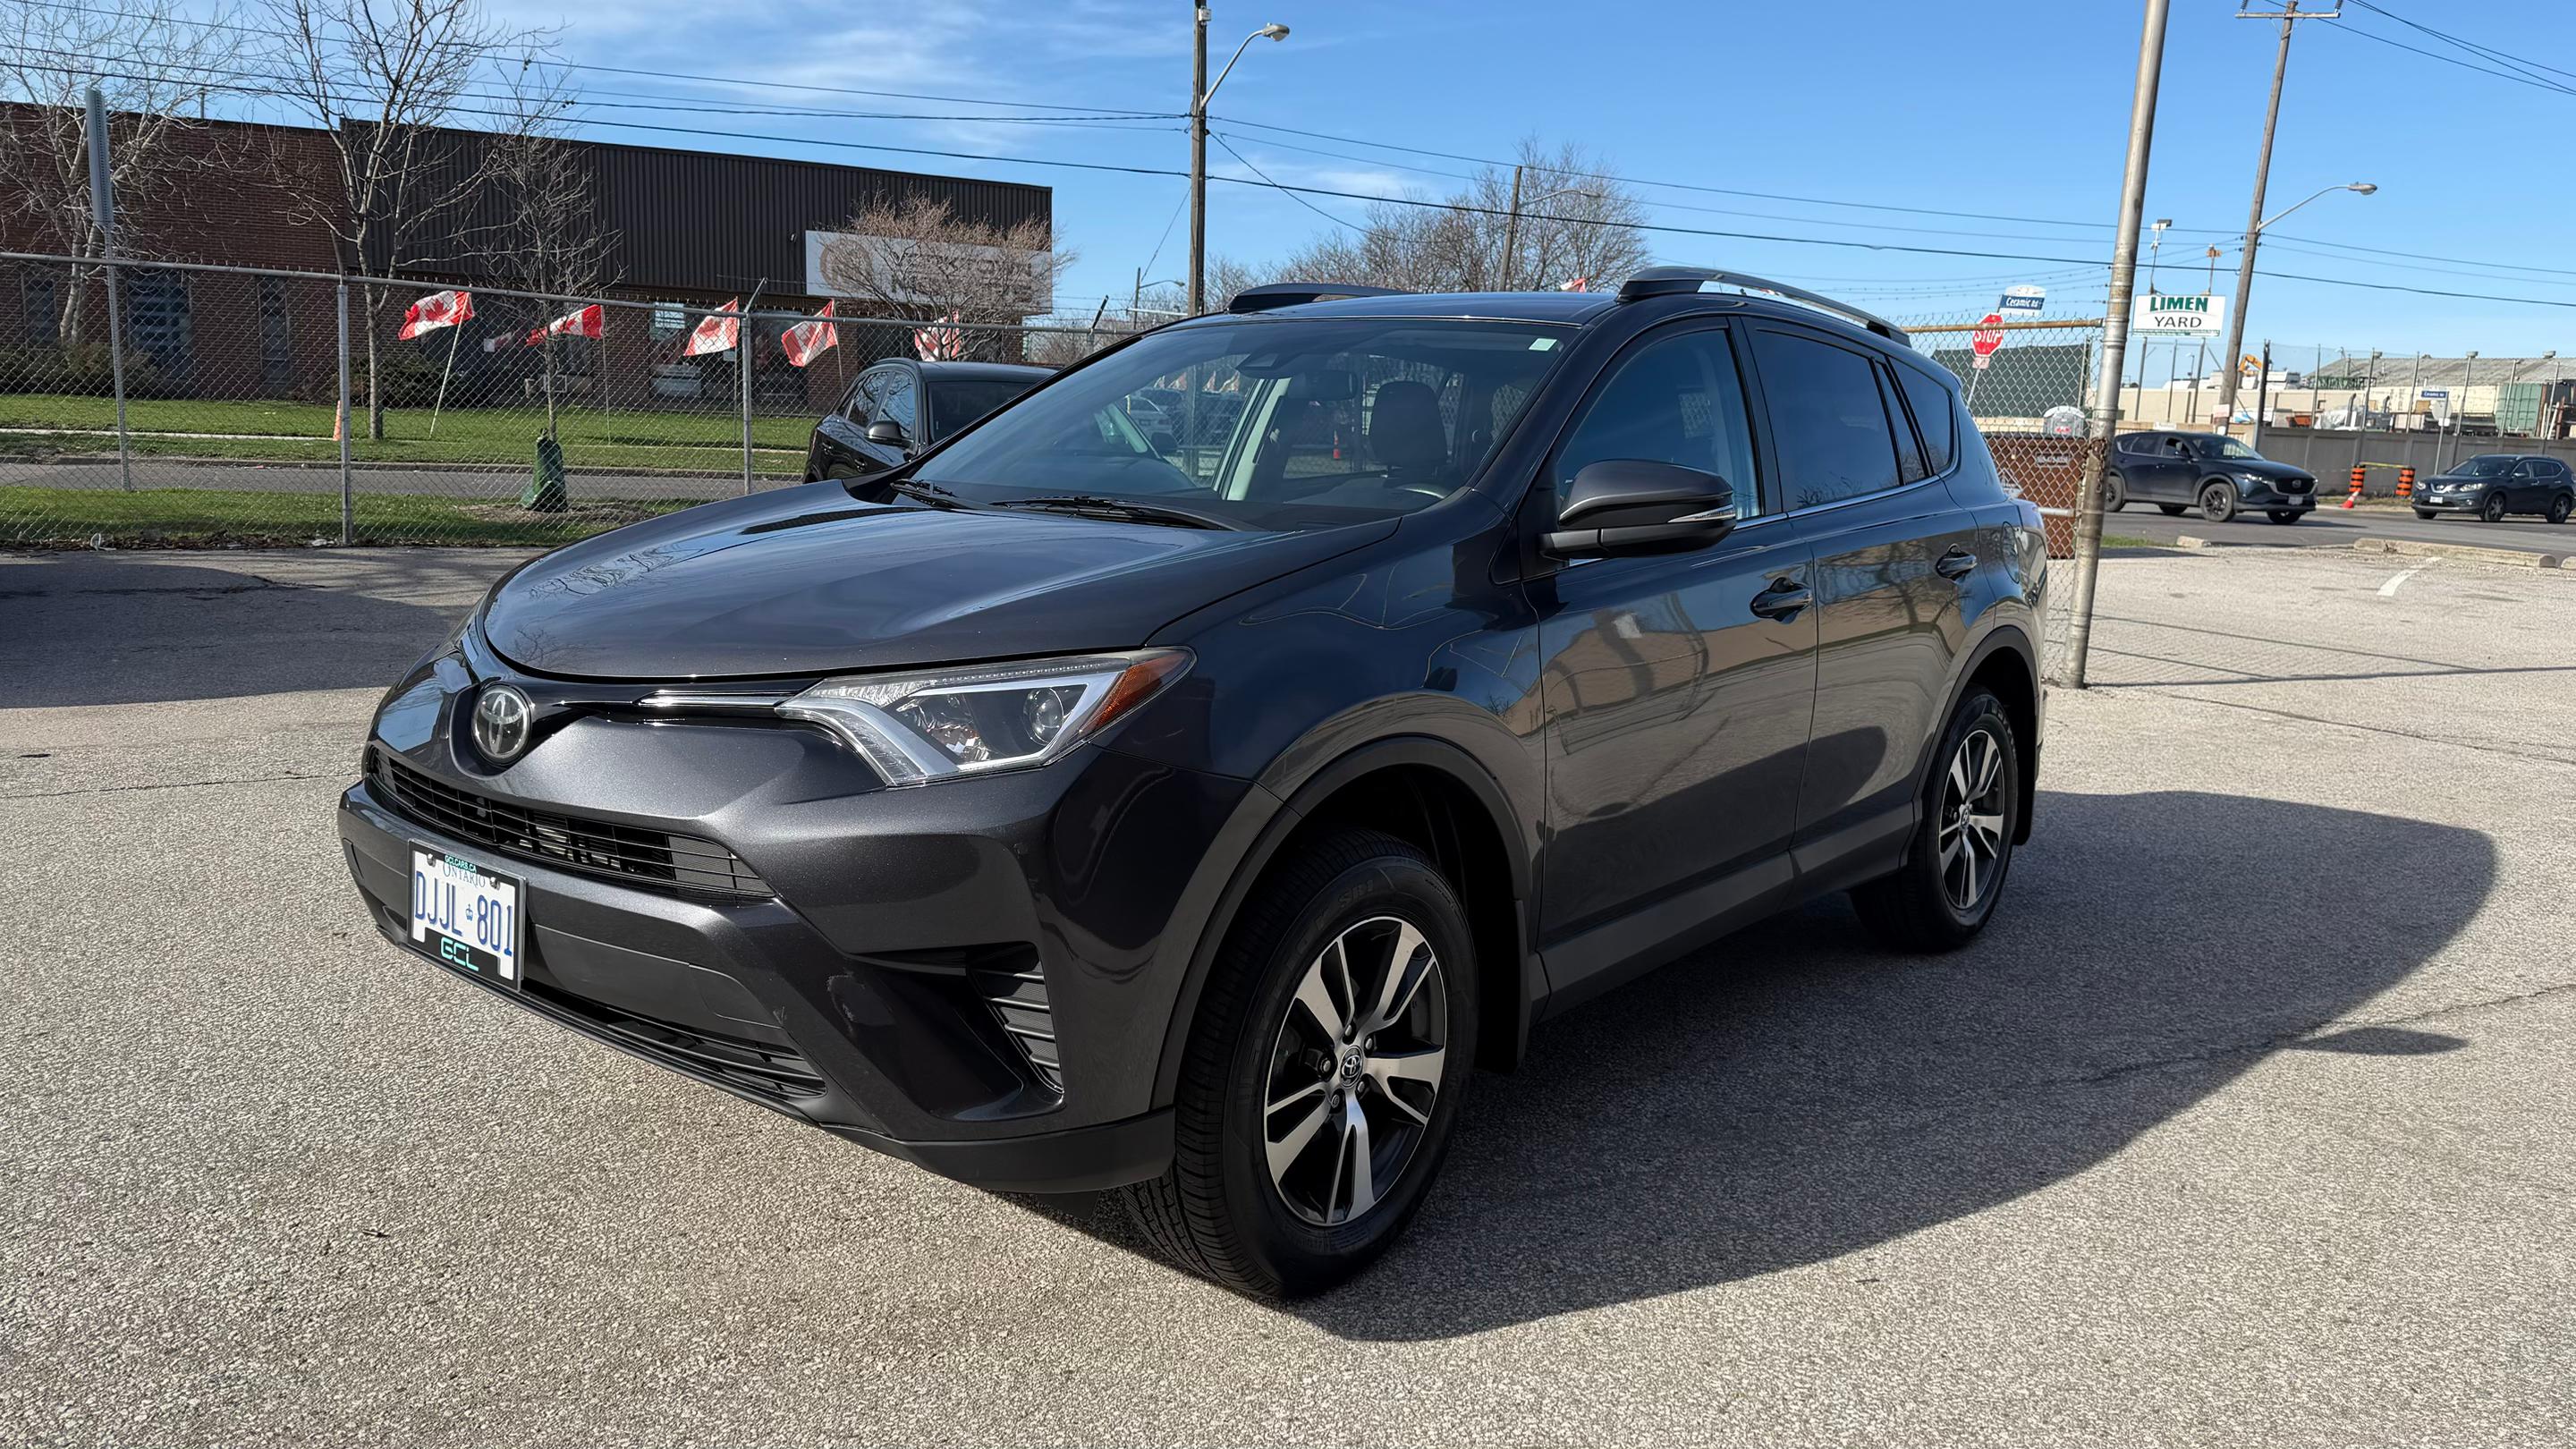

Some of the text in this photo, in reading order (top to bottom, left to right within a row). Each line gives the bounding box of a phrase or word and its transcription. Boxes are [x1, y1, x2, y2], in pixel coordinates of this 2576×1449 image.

[2149, 296, 2208, 312] LIMEN
[2154, 316, 2202, 328] YARD
[1974, 328, 2003, 343] STOP
[414, 870, 513, 957] DJJL 801
[441, 936, 479, 972] GCL
